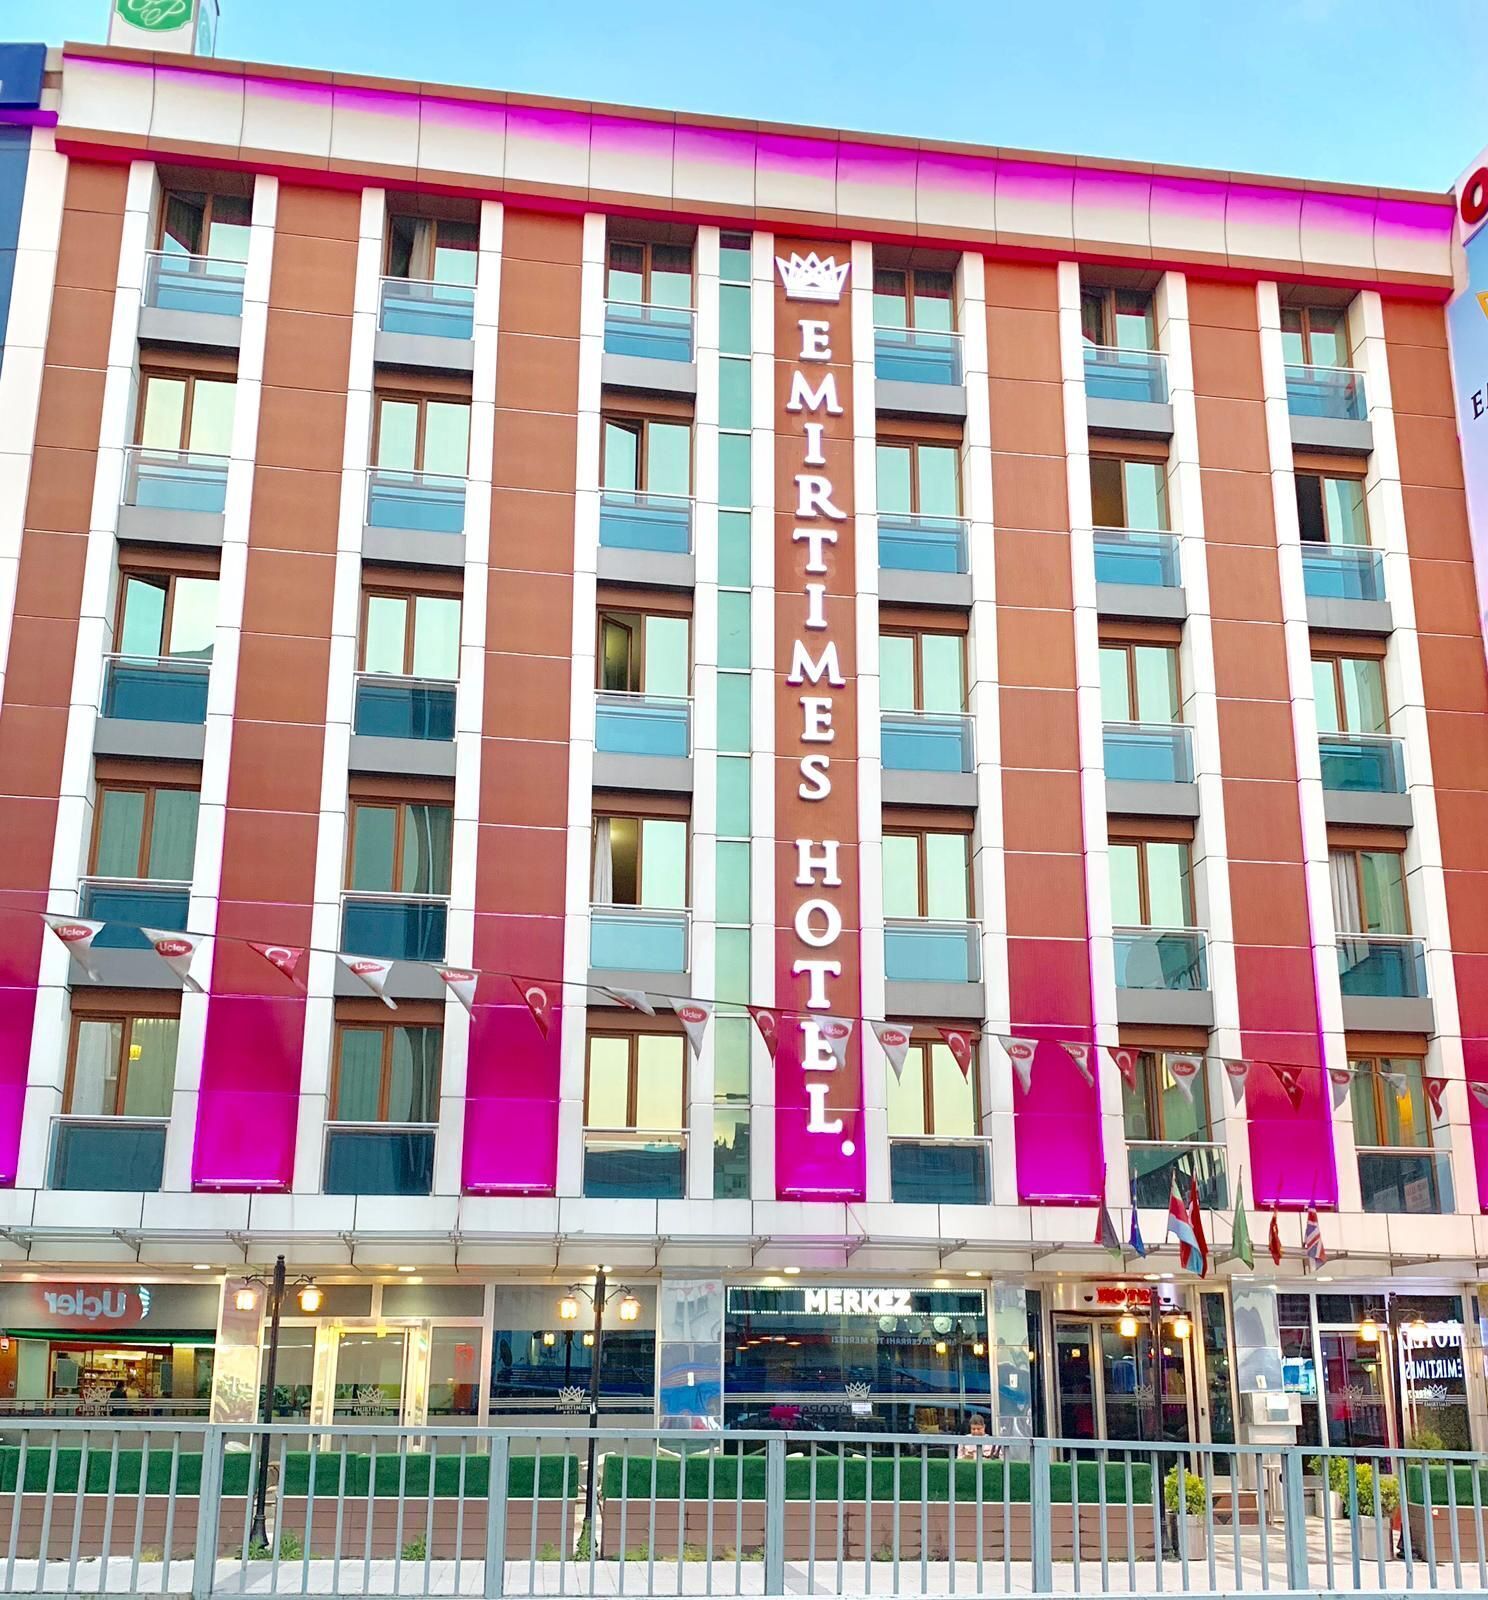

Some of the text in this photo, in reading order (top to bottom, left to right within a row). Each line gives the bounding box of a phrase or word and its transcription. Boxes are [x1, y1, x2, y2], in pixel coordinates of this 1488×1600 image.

[1470, 382, 1488, 420] E
[786, 318, 848, 802] EMIRTIMES
[804, 1289, 912, 1313] MERKEZ
